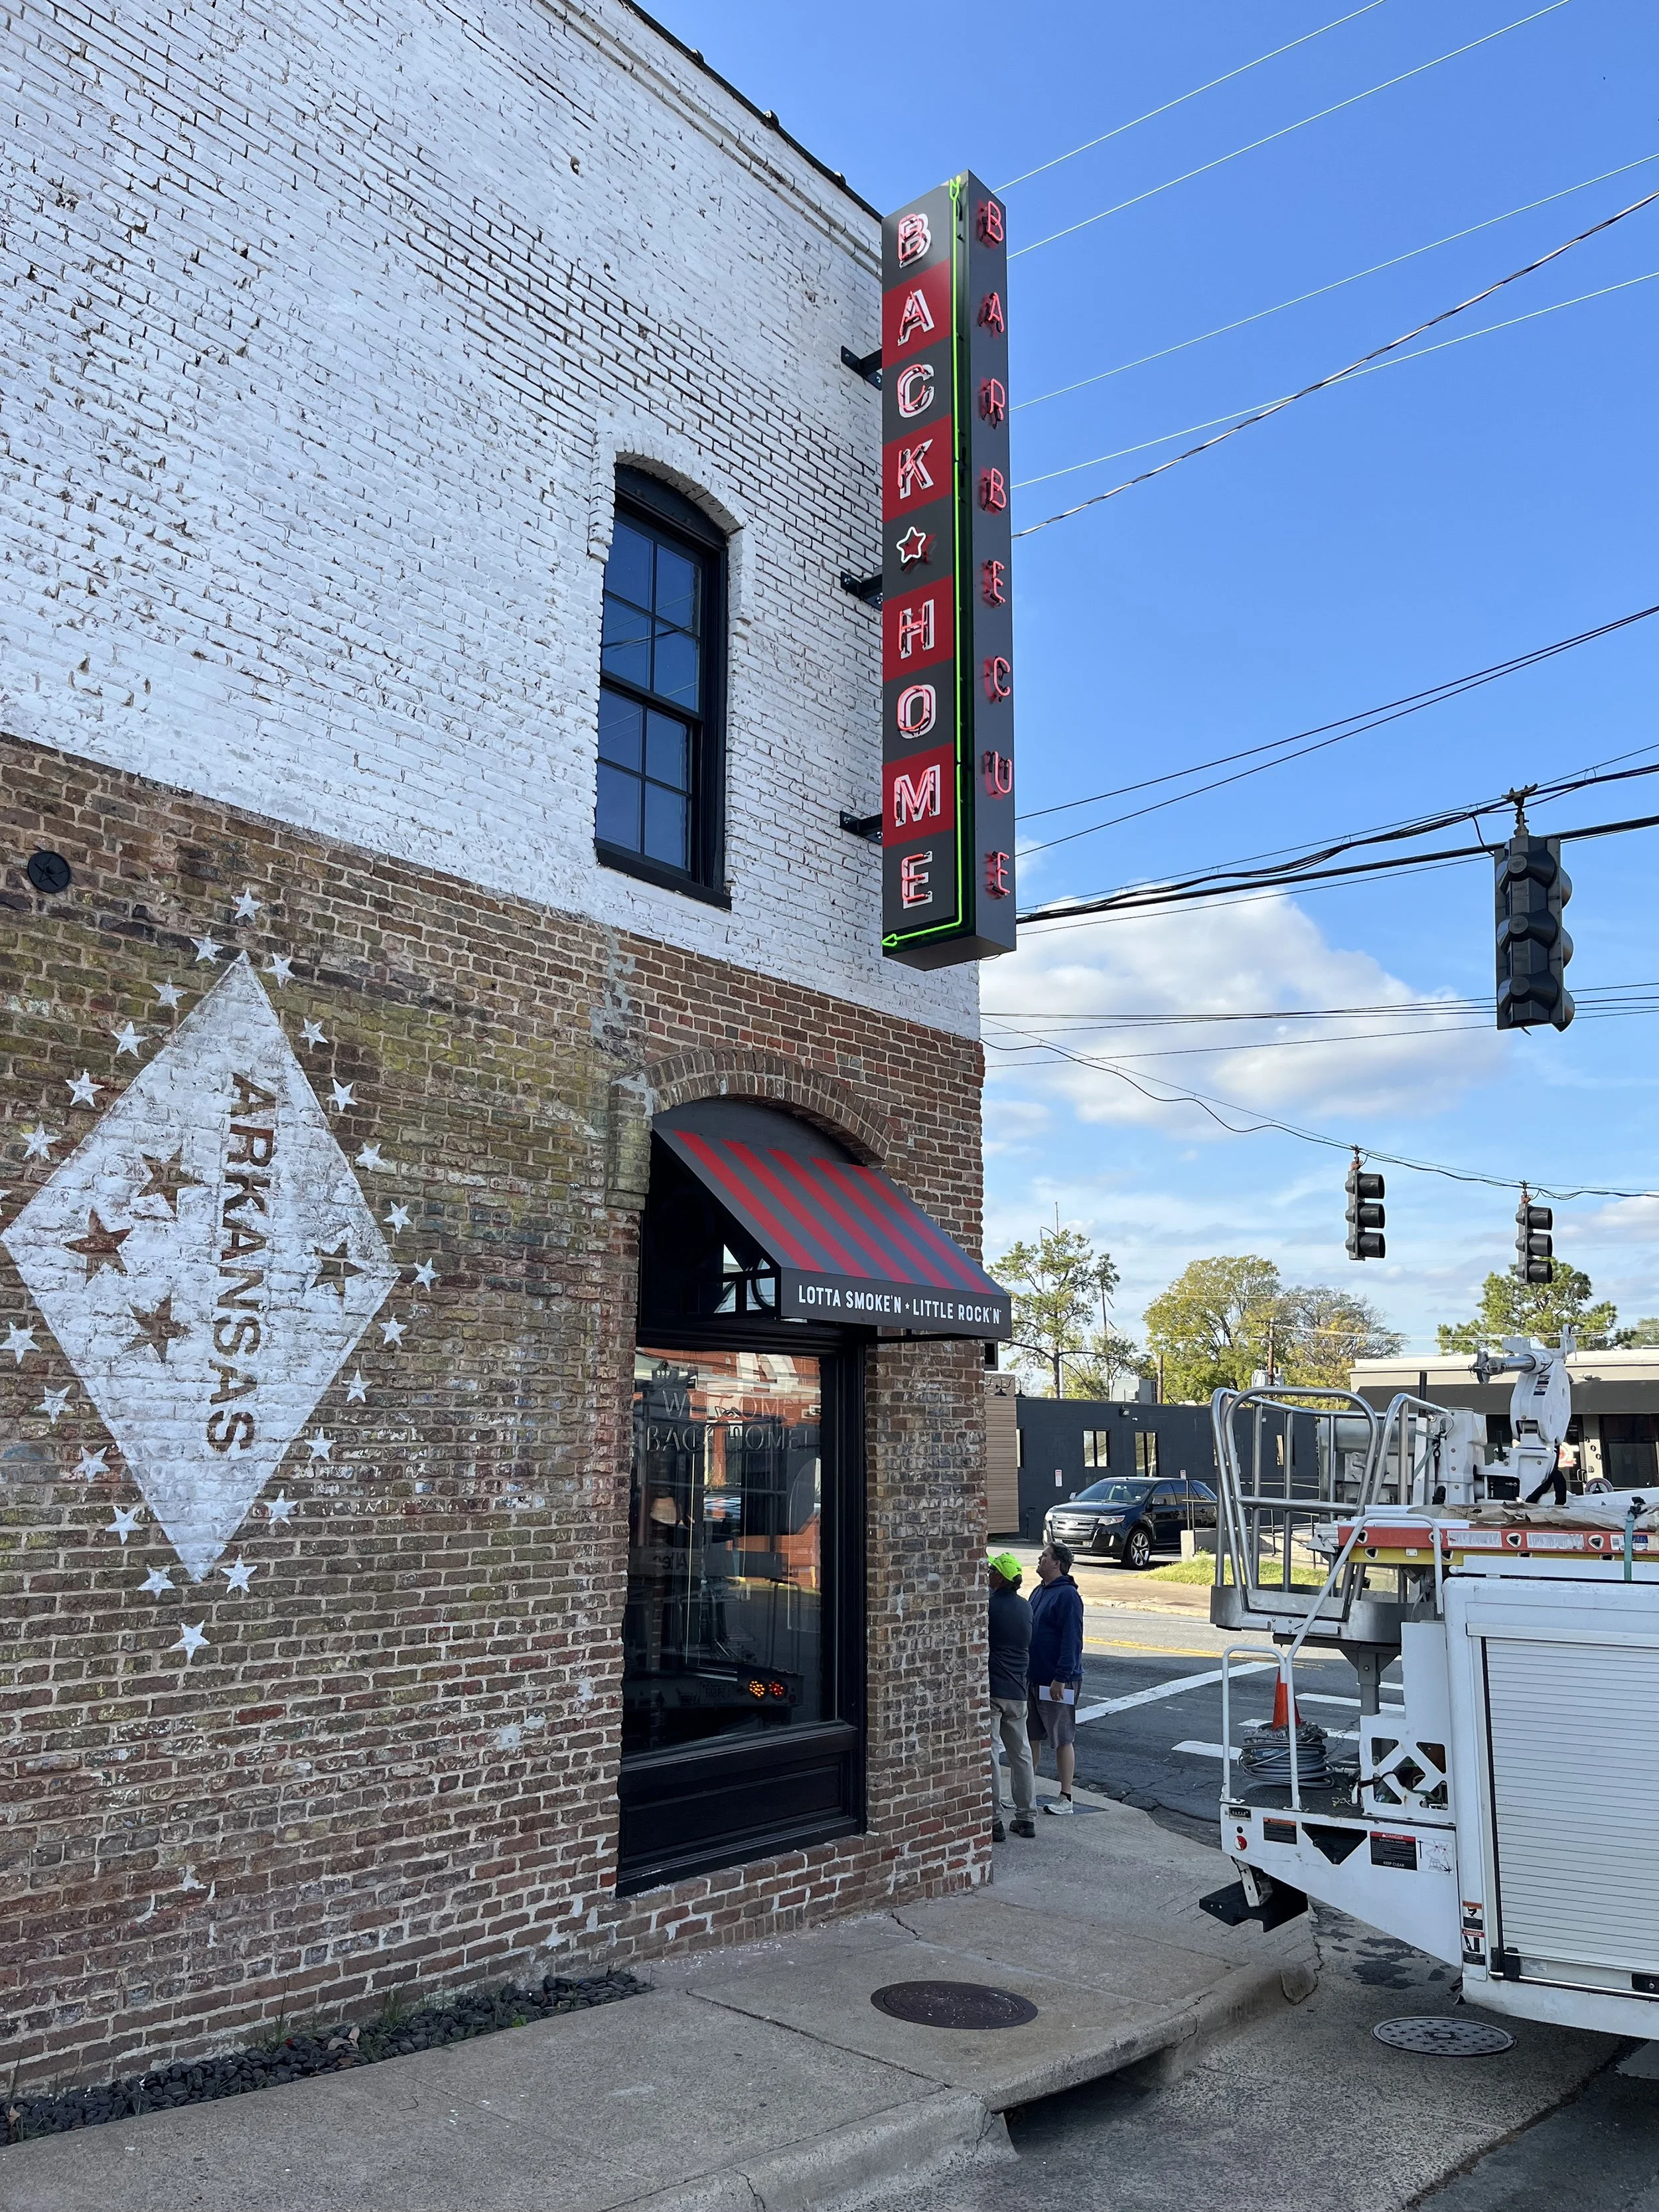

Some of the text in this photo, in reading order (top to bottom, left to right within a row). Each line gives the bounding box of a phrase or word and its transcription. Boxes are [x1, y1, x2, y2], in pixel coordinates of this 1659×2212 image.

[893, 213, 941, 909] BACK HOME
[980, 200, 1013, 897] BARBECUE
[206, 1072, 278, 1453] ARKANSAS
[662, 1390, 794, 1421] WCOME
[798, 1284, 841, 1307] LOTTA
[845, 1290, 902, 1313] SMOKE'N
[912, 1298, 954, 1319] LITTLE
